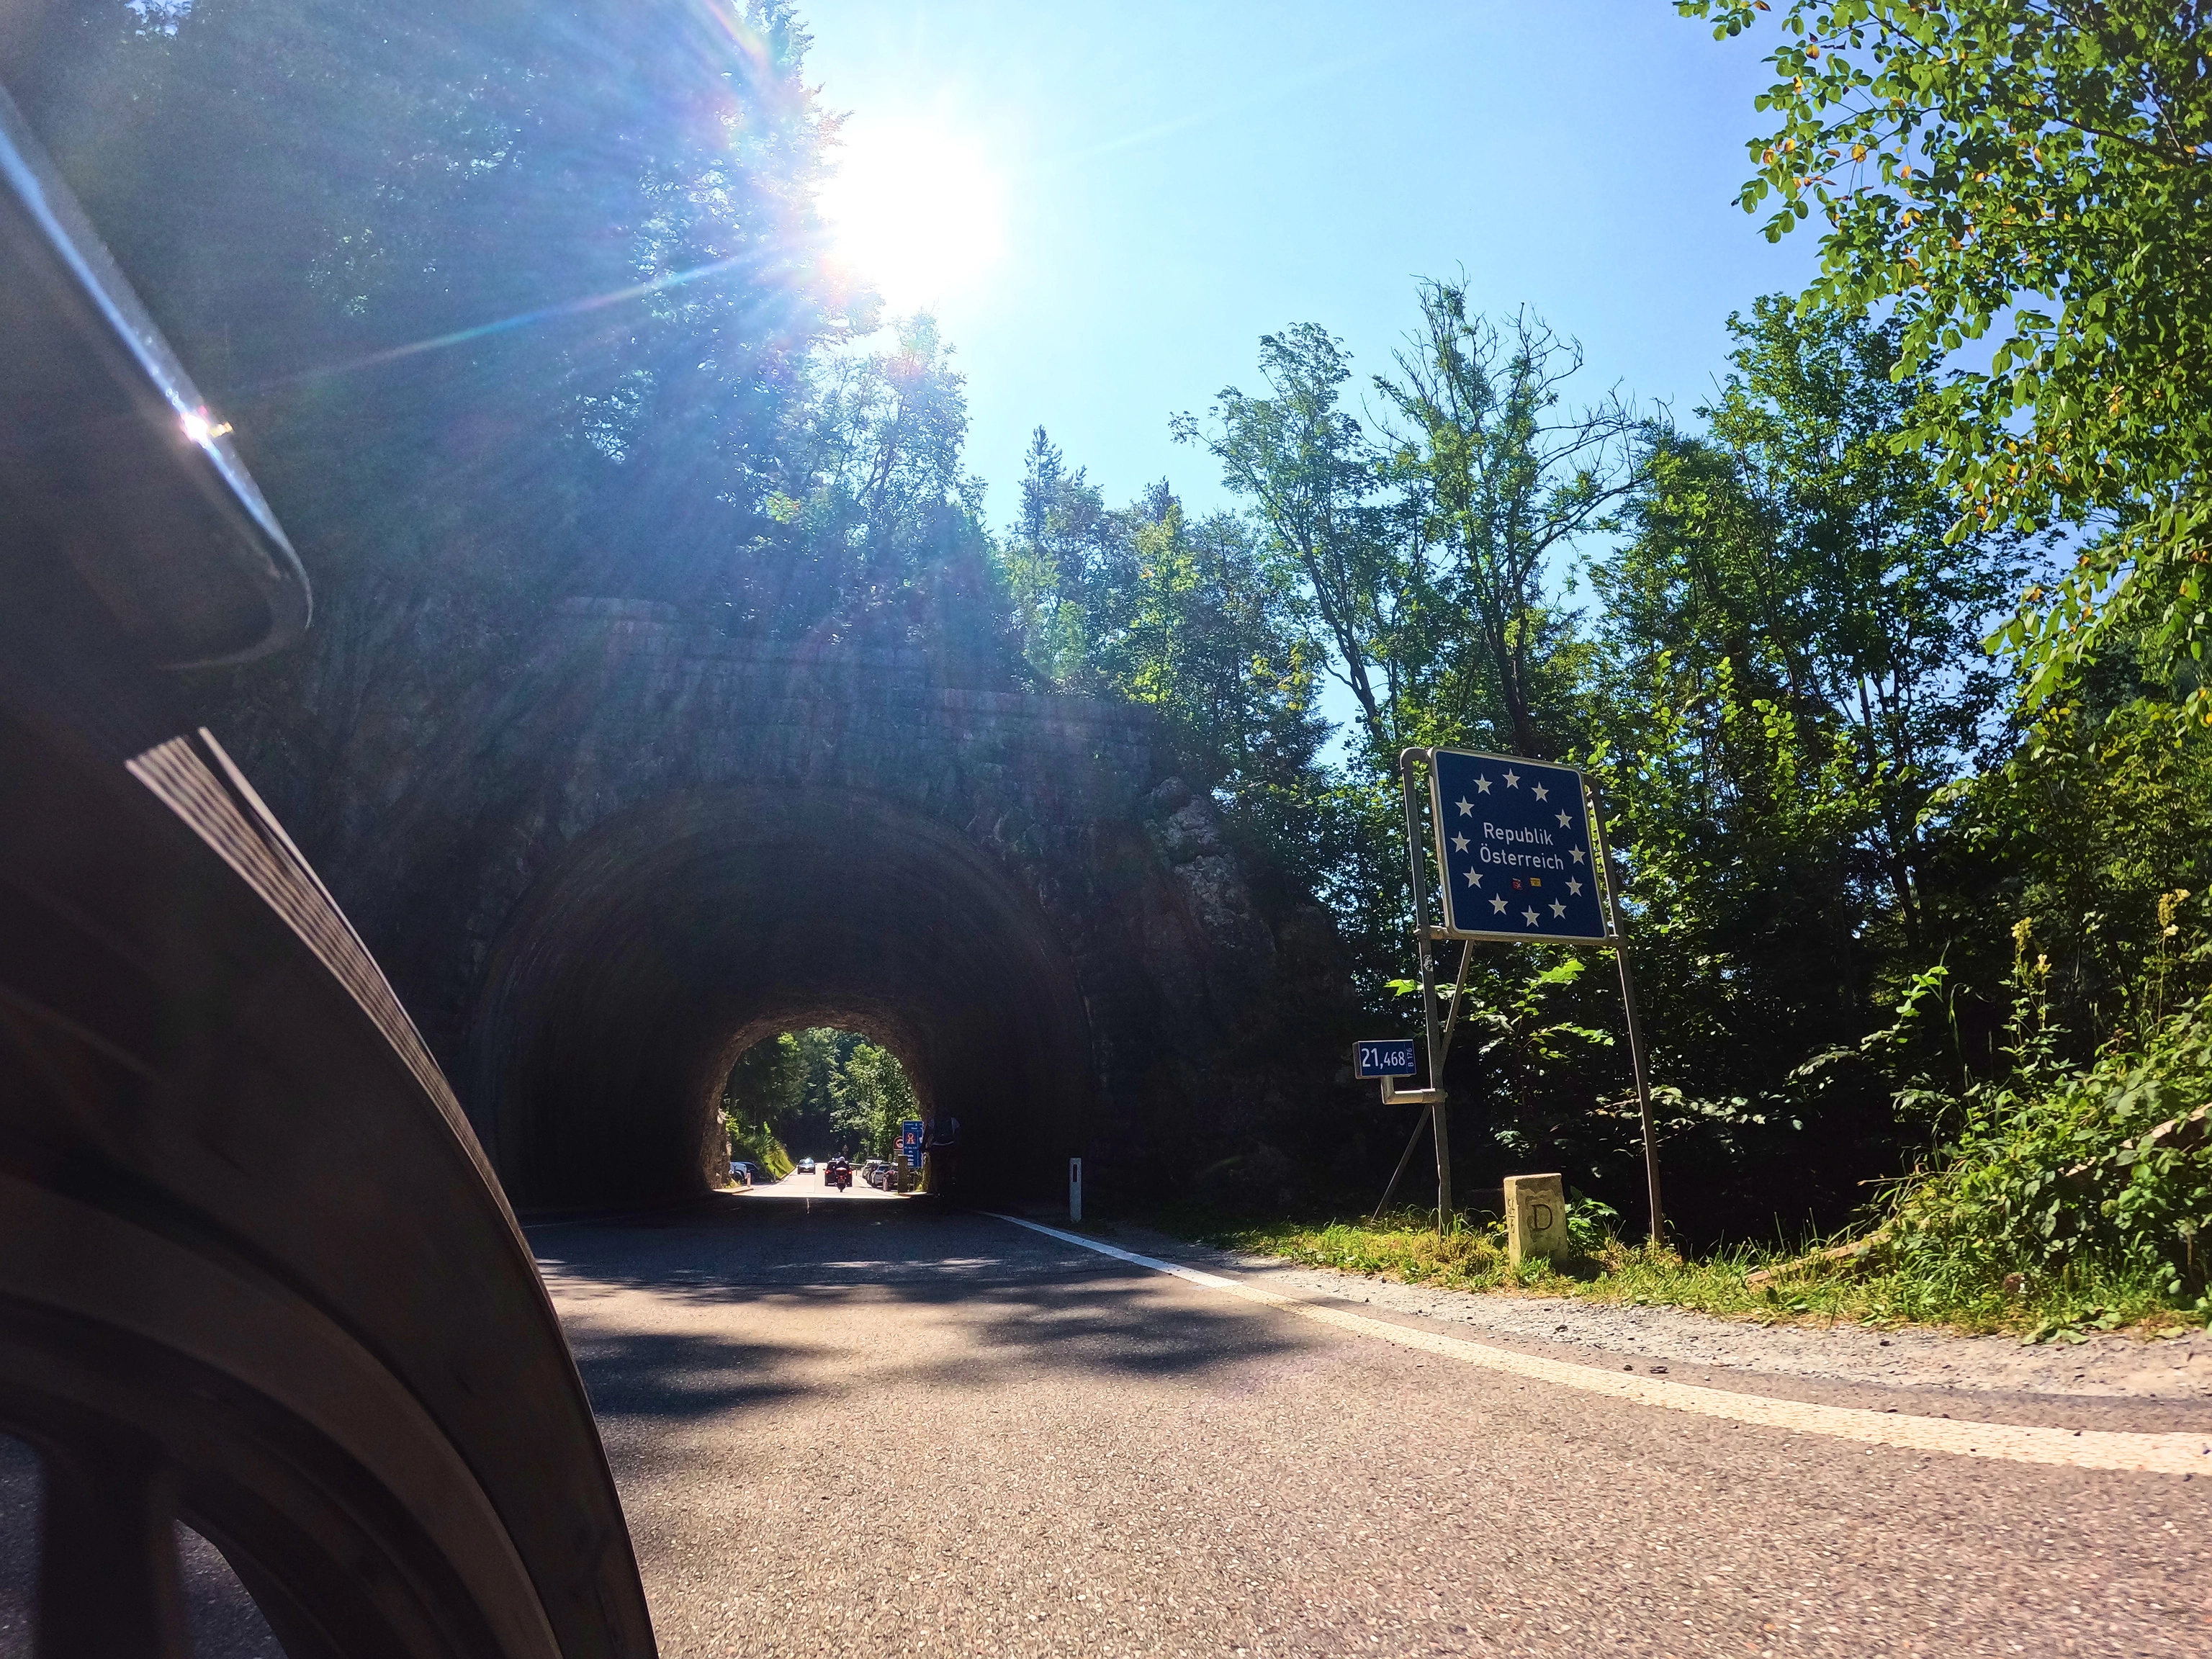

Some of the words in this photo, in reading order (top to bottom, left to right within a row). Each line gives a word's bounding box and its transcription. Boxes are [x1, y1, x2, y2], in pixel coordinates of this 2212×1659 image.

[1483, 822, 1554, 846] Republik
[1480, 843, 1565, 871] Österreich
[1361, 1048, 1406, 1069] 21,468
[1531, 1203, 1553, 1231] D
